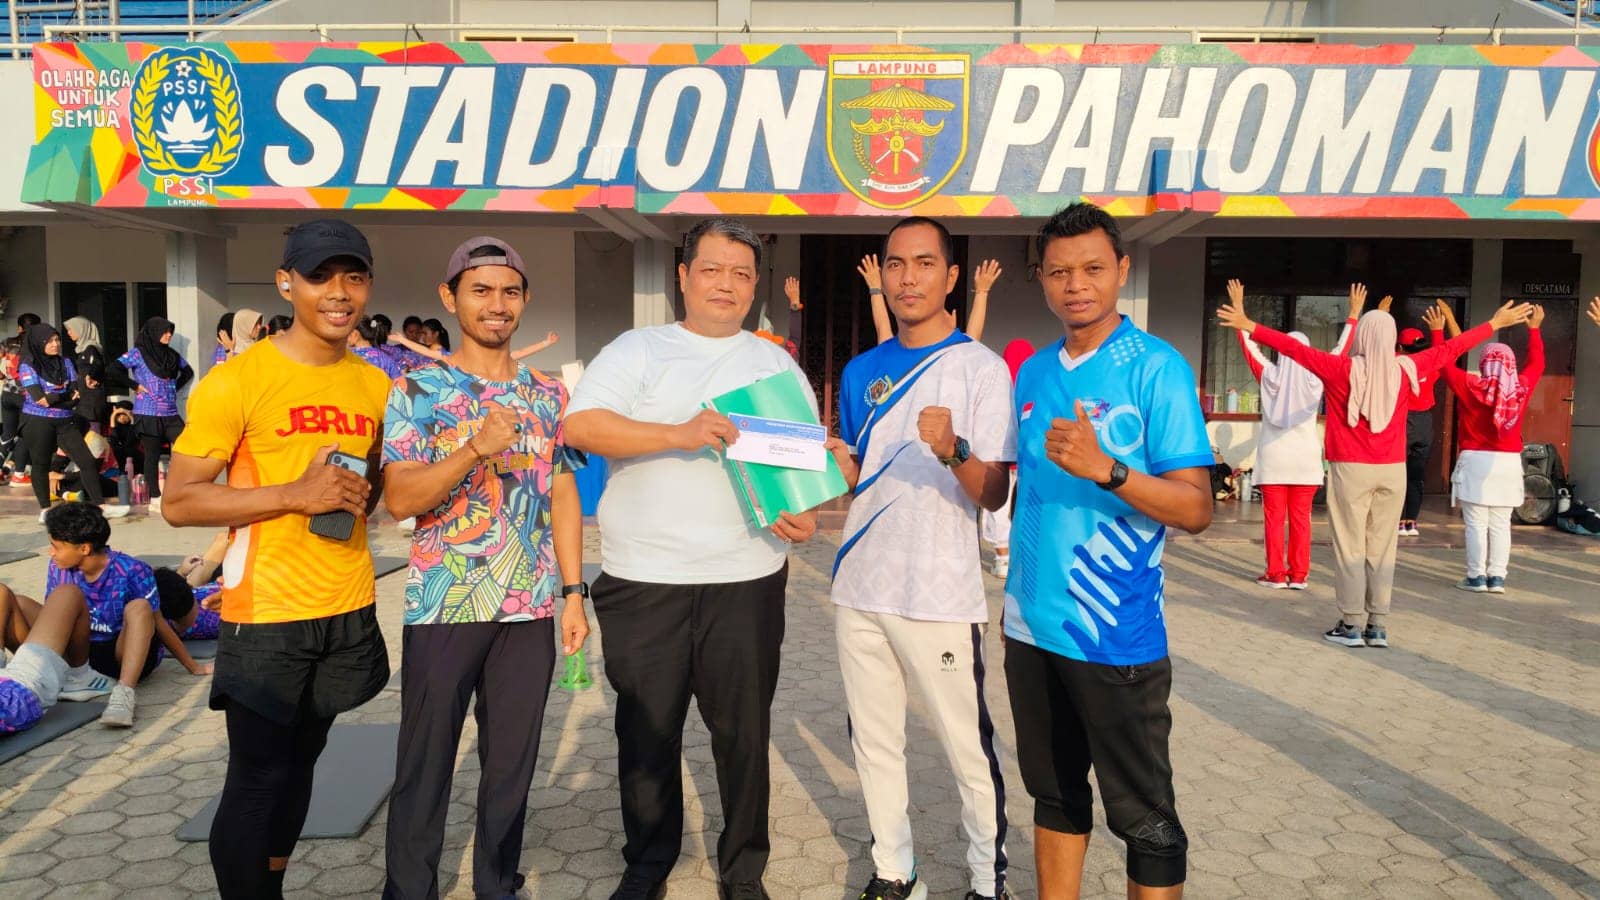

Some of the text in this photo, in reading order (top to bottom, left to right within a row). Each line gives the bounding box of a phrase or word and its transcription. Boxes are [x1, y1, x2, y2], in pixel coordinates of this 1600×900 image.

[857, 62, 938, 74] LAMPUNG
[41, 69, 131, 88] OLAHRAGA
[162, 79, 207, 97] PSSI
[58, 88, 120, 106] UNTUK
[51, 109, 121, 128] SEMUA
[264, 65, 1596, 195] STADION PAHOMAN
[164, 176, 213, 195] PSSI
[484, 452, 535, 474] TEAM
